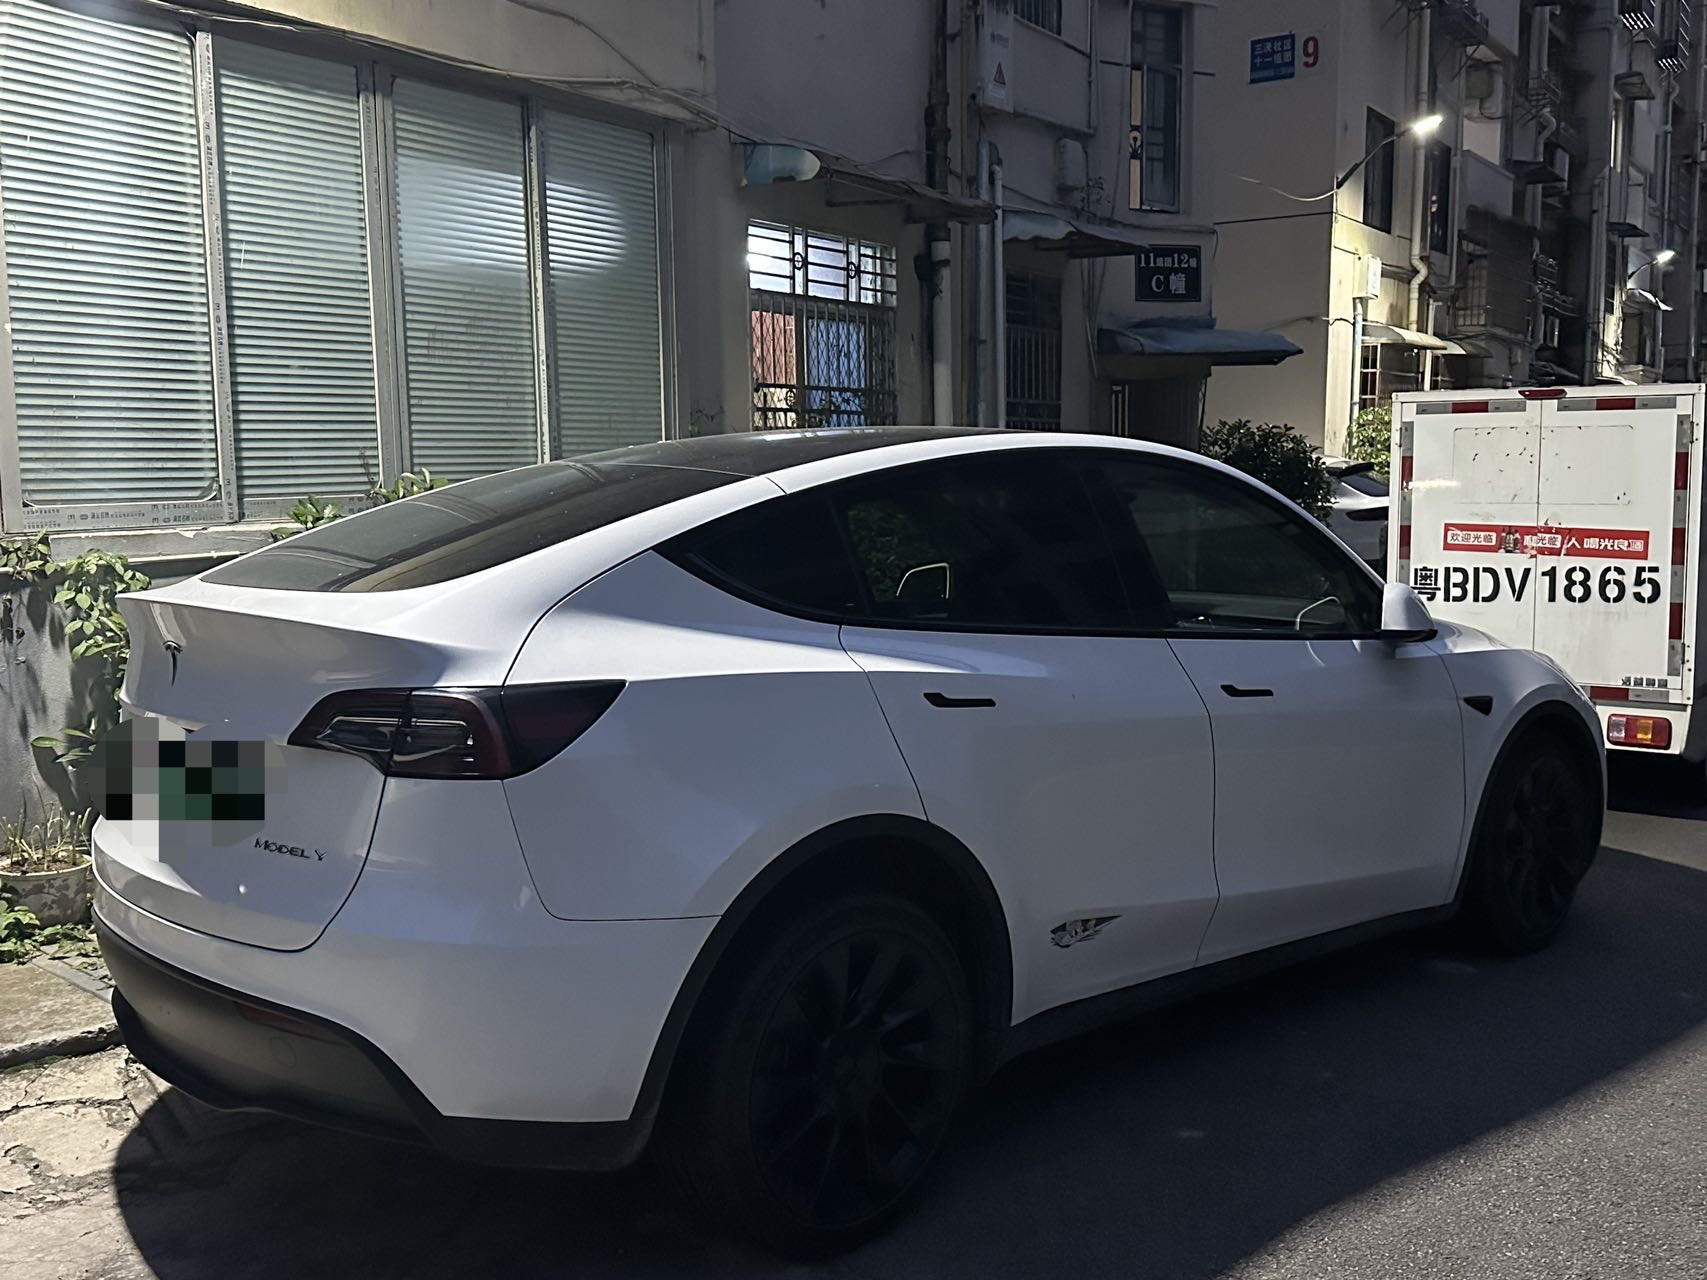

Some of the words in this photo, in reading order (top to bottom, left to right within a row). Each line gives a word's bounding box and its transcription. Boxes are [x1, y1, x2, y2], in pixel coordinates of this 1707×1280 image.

[1303, 36, 1318, 68] 9
[1450, 532, 1494, 543] 欢迎光临
[254, 837, 311, 859] MODEL
[314, 850, 327, 861] Y
